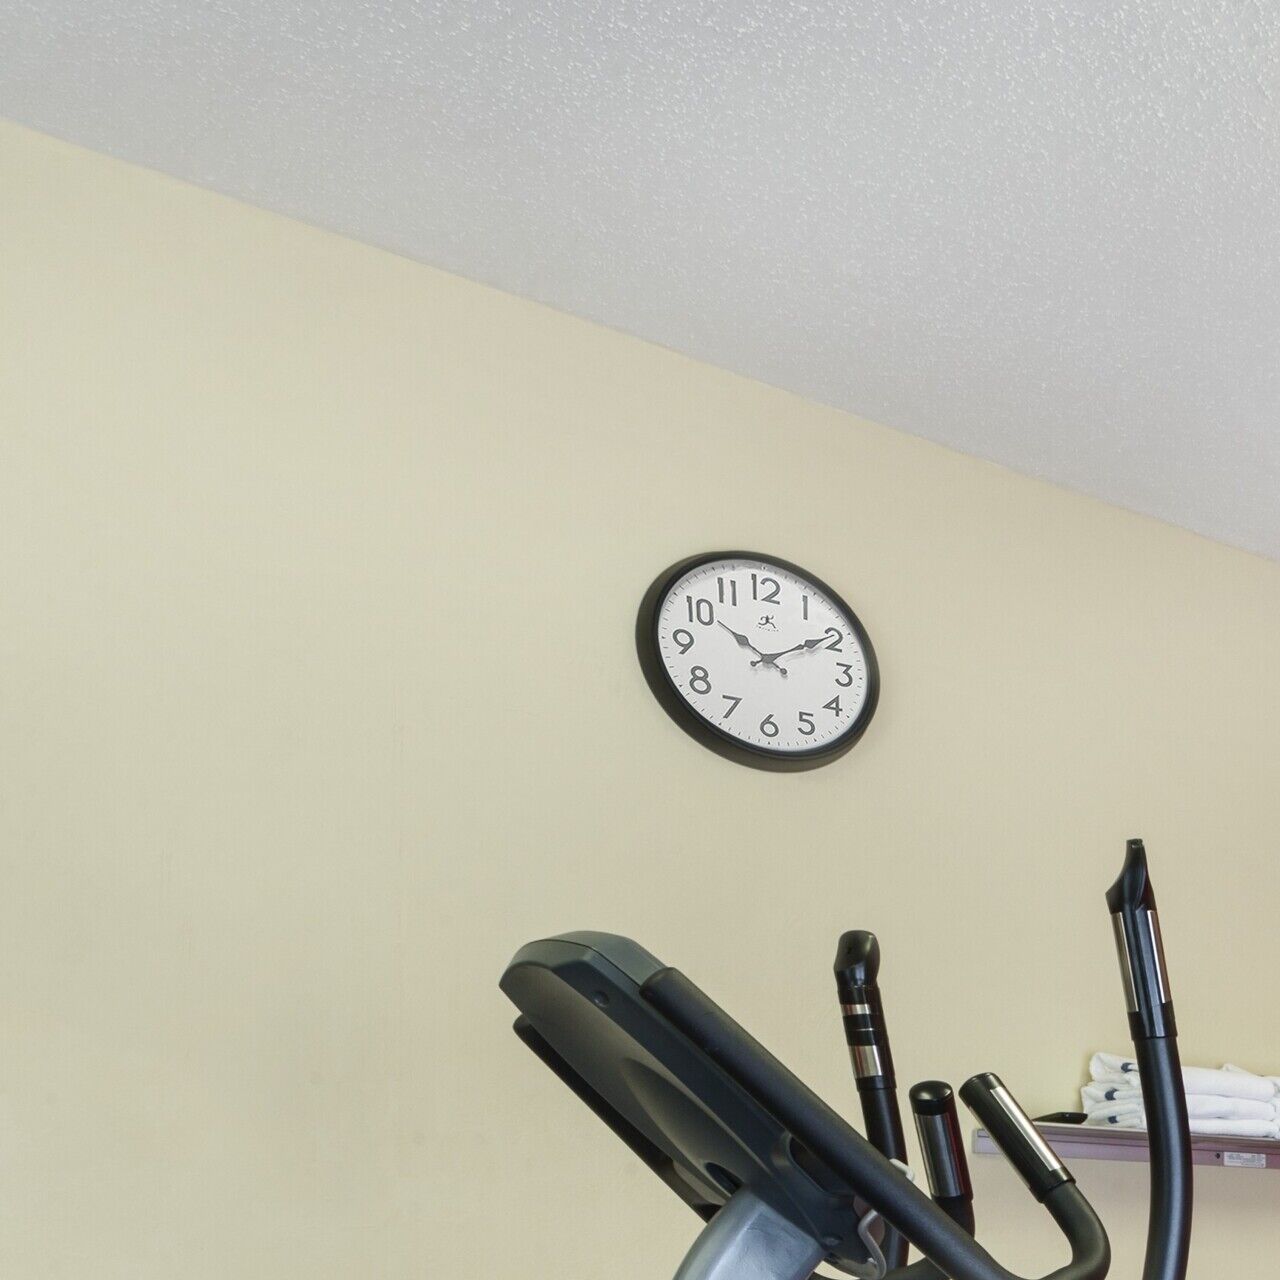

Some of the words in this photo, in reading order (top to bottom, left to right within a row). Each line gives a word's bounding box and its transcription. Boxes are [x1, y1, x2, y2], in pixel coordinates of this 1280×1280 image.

[717, 577, 737, 607] 11
[751, 573, 781, 605] 12
[686, 595, 714, 626] 10
[802, 595, 808, 620] 1
[672, 628, 695, 655] 9
[824, 627, 843, 652] 2
[689, 665, 711, 695] 8
[835, 662, 853, 687] 3
[722, 694, 743, 719] 7
[822, 695, 843, 717] 4
[759, 713, 779, 737] 6
[797, 711, 815, 735] 5
